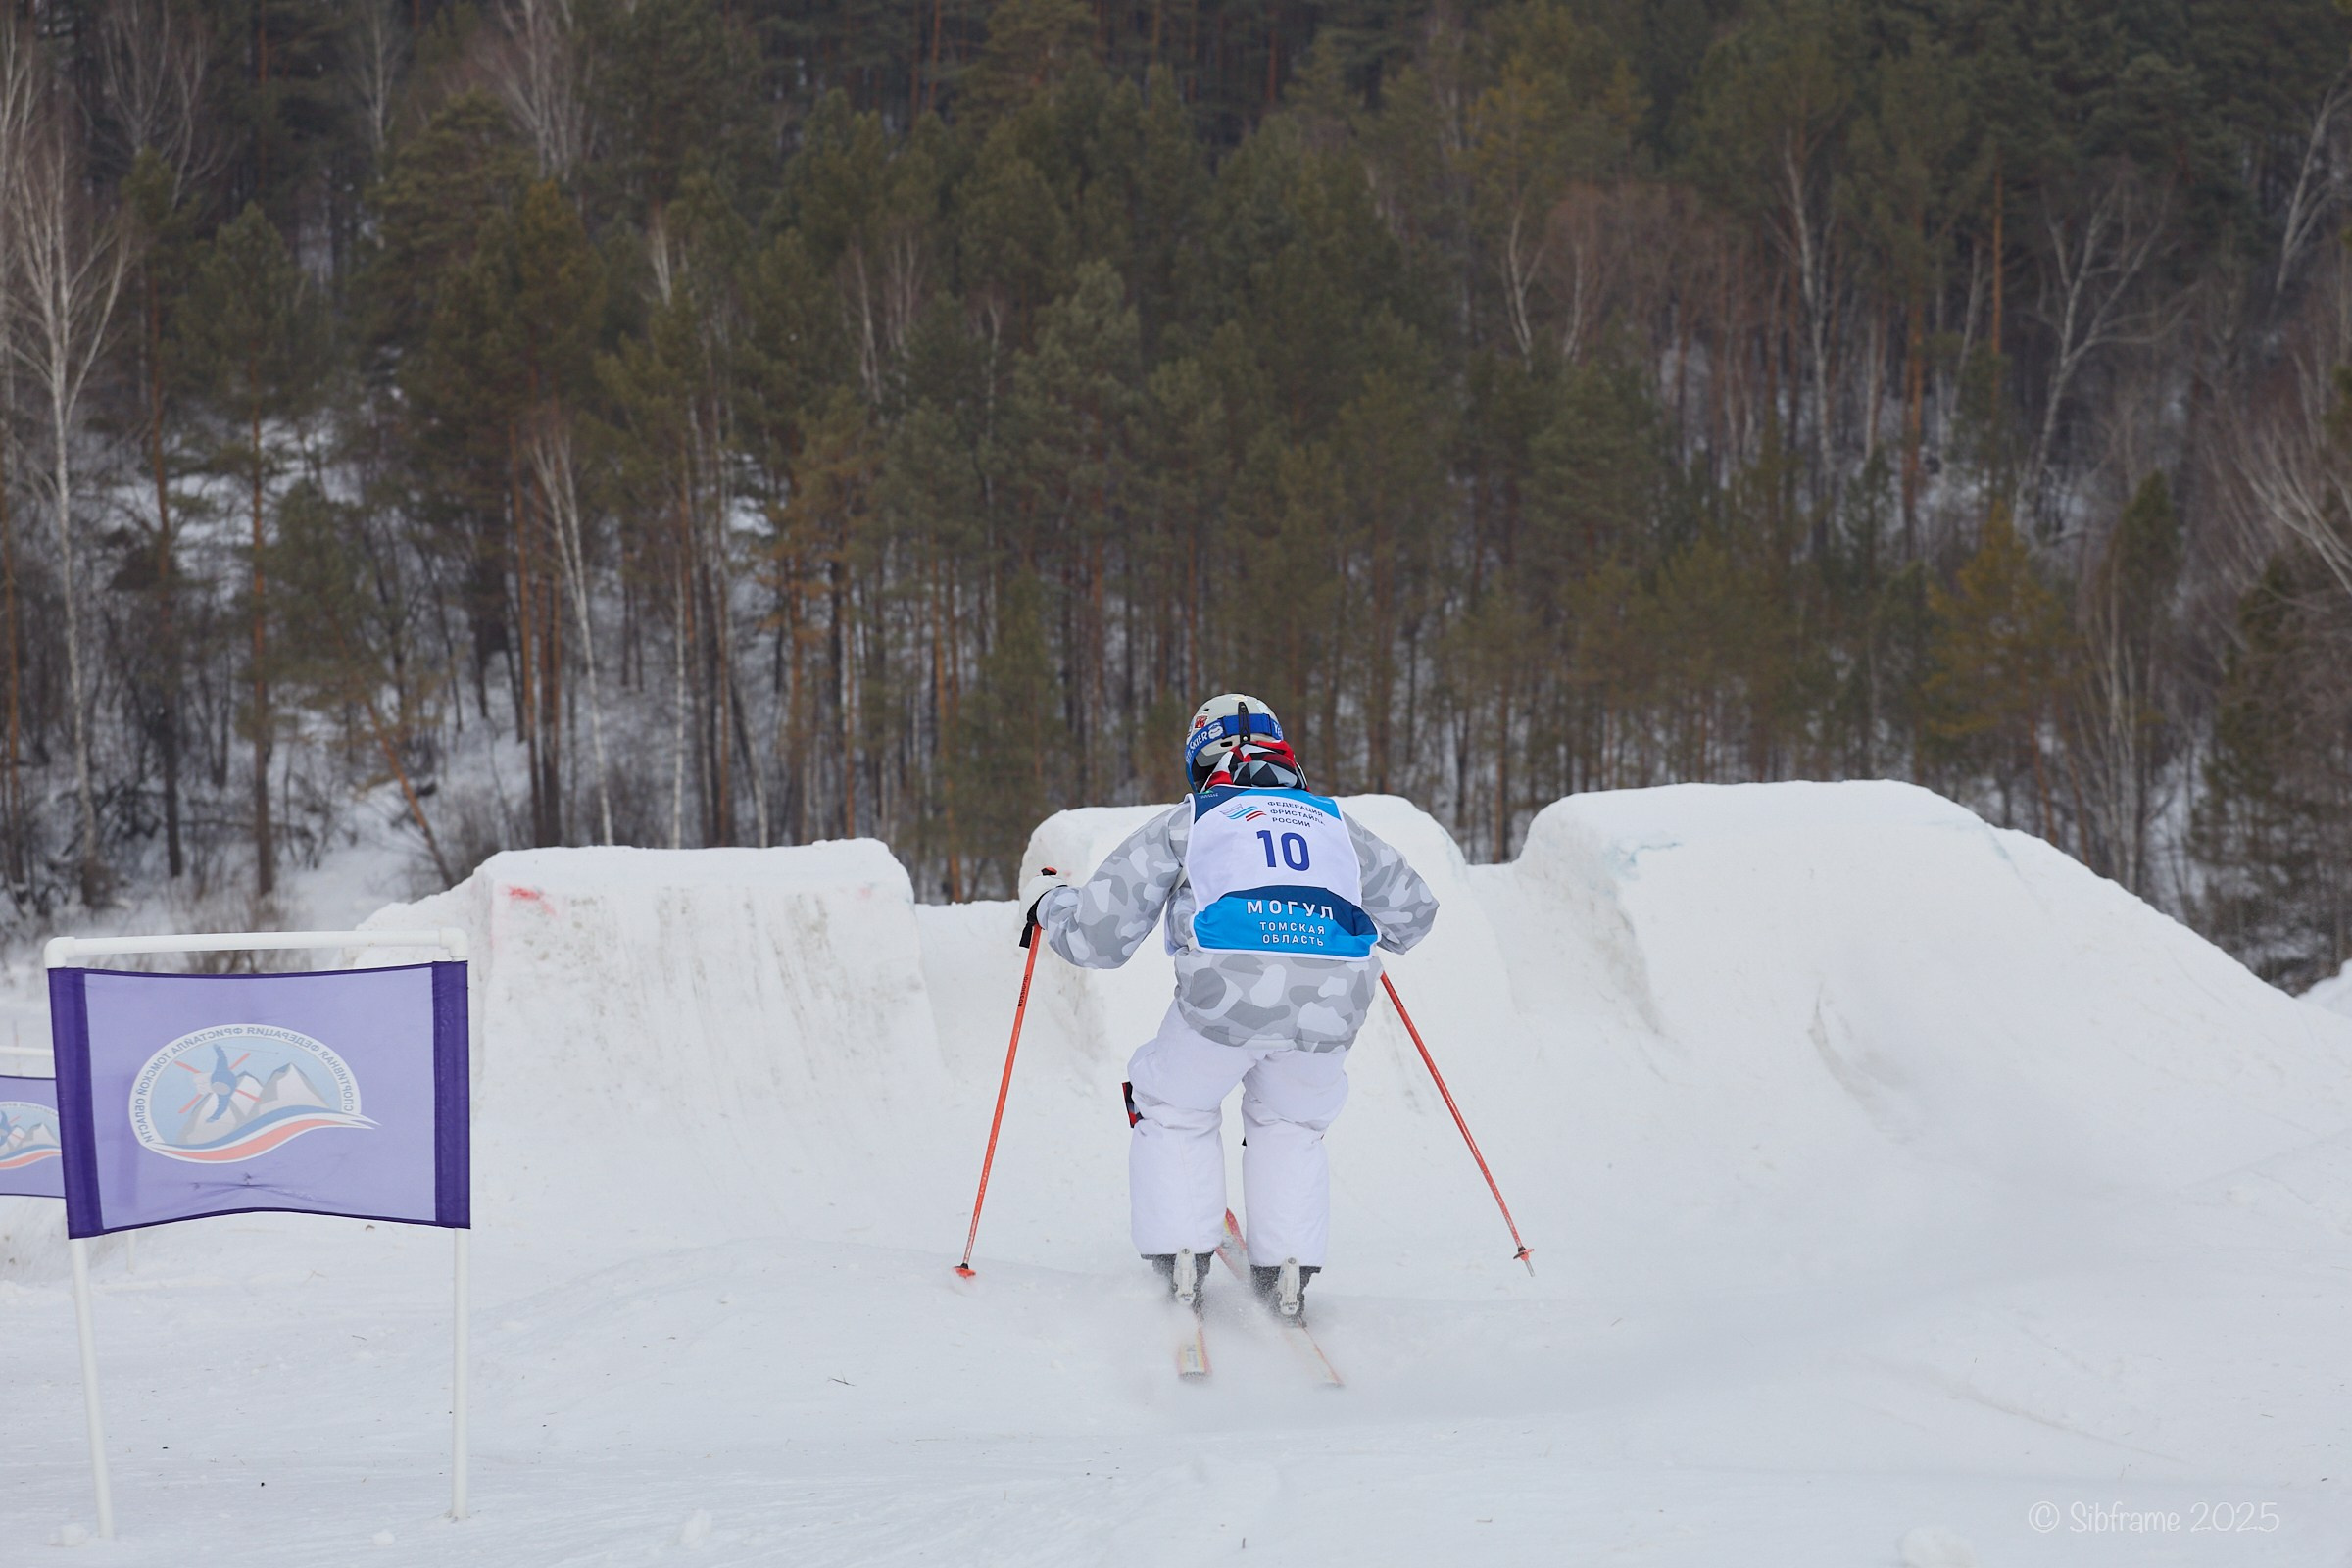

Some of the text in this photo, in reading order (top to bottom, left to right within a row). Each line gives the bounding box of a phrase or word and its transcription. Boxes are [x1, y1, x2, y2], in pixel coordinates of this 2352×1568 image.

[1267, 801, 1324, 818] ФЕДЕРАЦИЯ
[1272, 817, 1311, 828] РОССИИ
[1256, 829, 1310, 872] 10
[1247, 900, 1334, 920] МОГУЛ
[1259, 922, 1325, 935] ТОМСКАЯ
[1262, 934, 1324, 947] ОБЛАСТЬ
